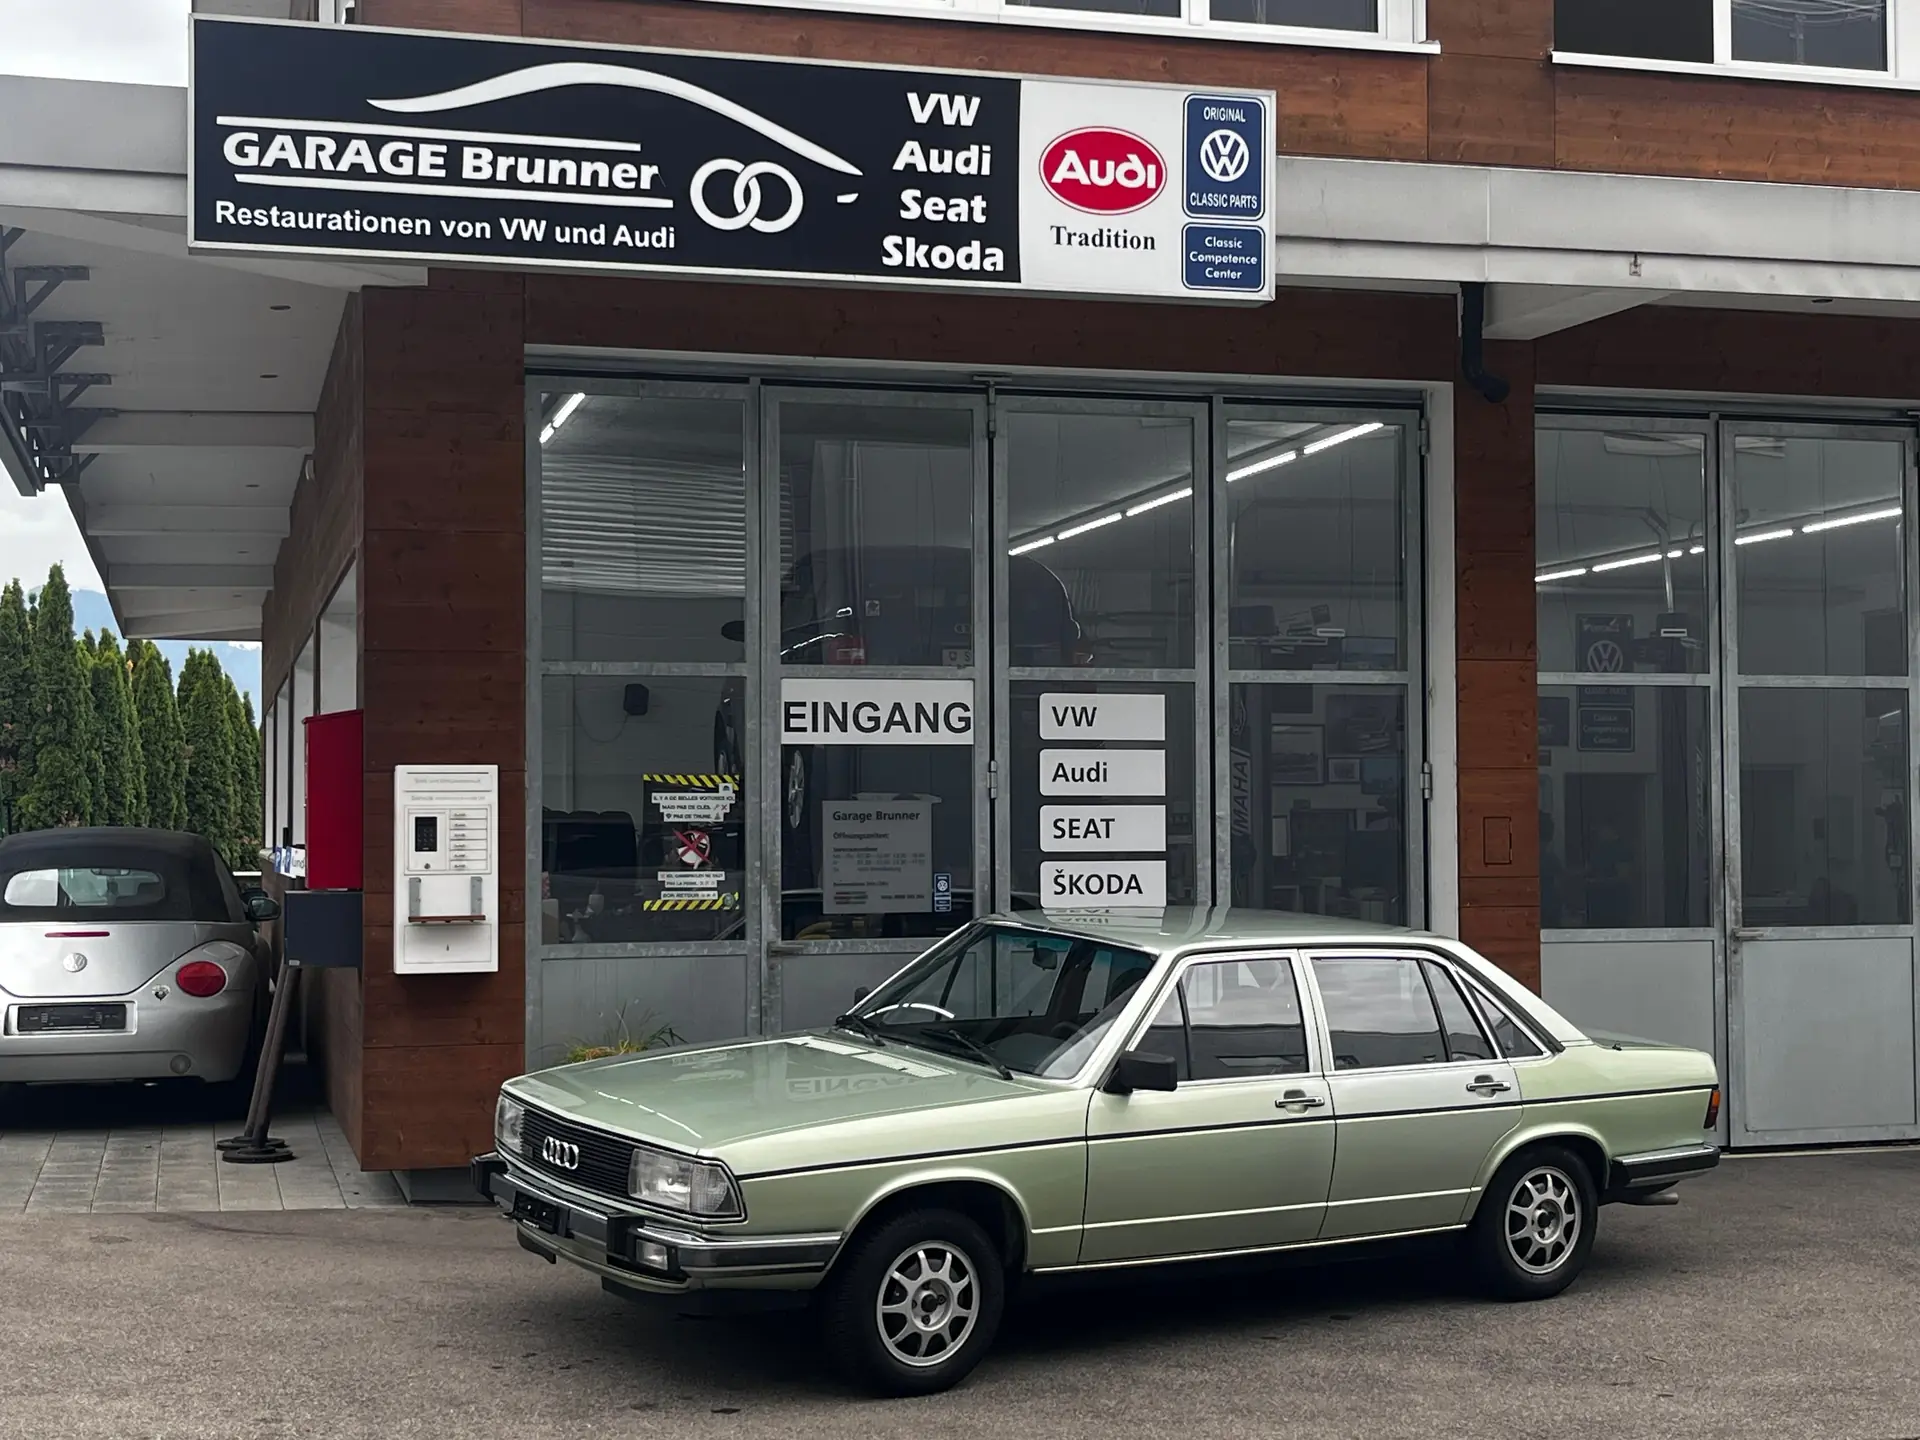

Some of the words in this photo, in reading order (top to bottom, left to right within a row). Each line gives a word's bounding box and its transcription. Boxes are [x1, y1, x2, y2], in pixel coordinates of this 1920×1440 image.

[906, 92, 981, 127] VW
[1203, 106, 1246, 122] ORIGINAL
[223, 132, 448, 178] GARAGE
[461, 145, 659, 190] Brunner
[892, 140, 991, 176] Audi
[1050, 149, 1157, 189] Audi
[899, 188, 987, 224] Seat
[1189, 191, 1228, 208] CLASSIC
[1229, 194, 1258, 210] PARTS
[215, 200, 431, 236] Restaurationen
[439, 219, 491, 239] von
[499, 217, 547, 242] VW
[555, 223, 606, 246] und
[612, 224, 675, 249] Audi
[1050, 225, 1156, 251] Tradition
[1204, 236, 1243, 249] Classic
[881, 235, 1004, 272] Skoda
[1189, 251, 1258, 266] Competence
[1205, 267, 1243, 280] Center
[783, 700, 972, 734] EINGANG
[1051, 705, 1098, 727] VW
[1051, 761, 1108, 783] Audi
[832, 810, 873, 824] Garage
[875, 810, 921, 822] Brunner
[1052, 817, 1116, 840] SEAT
[1053, 868, 1144, 896] ŠKODA
